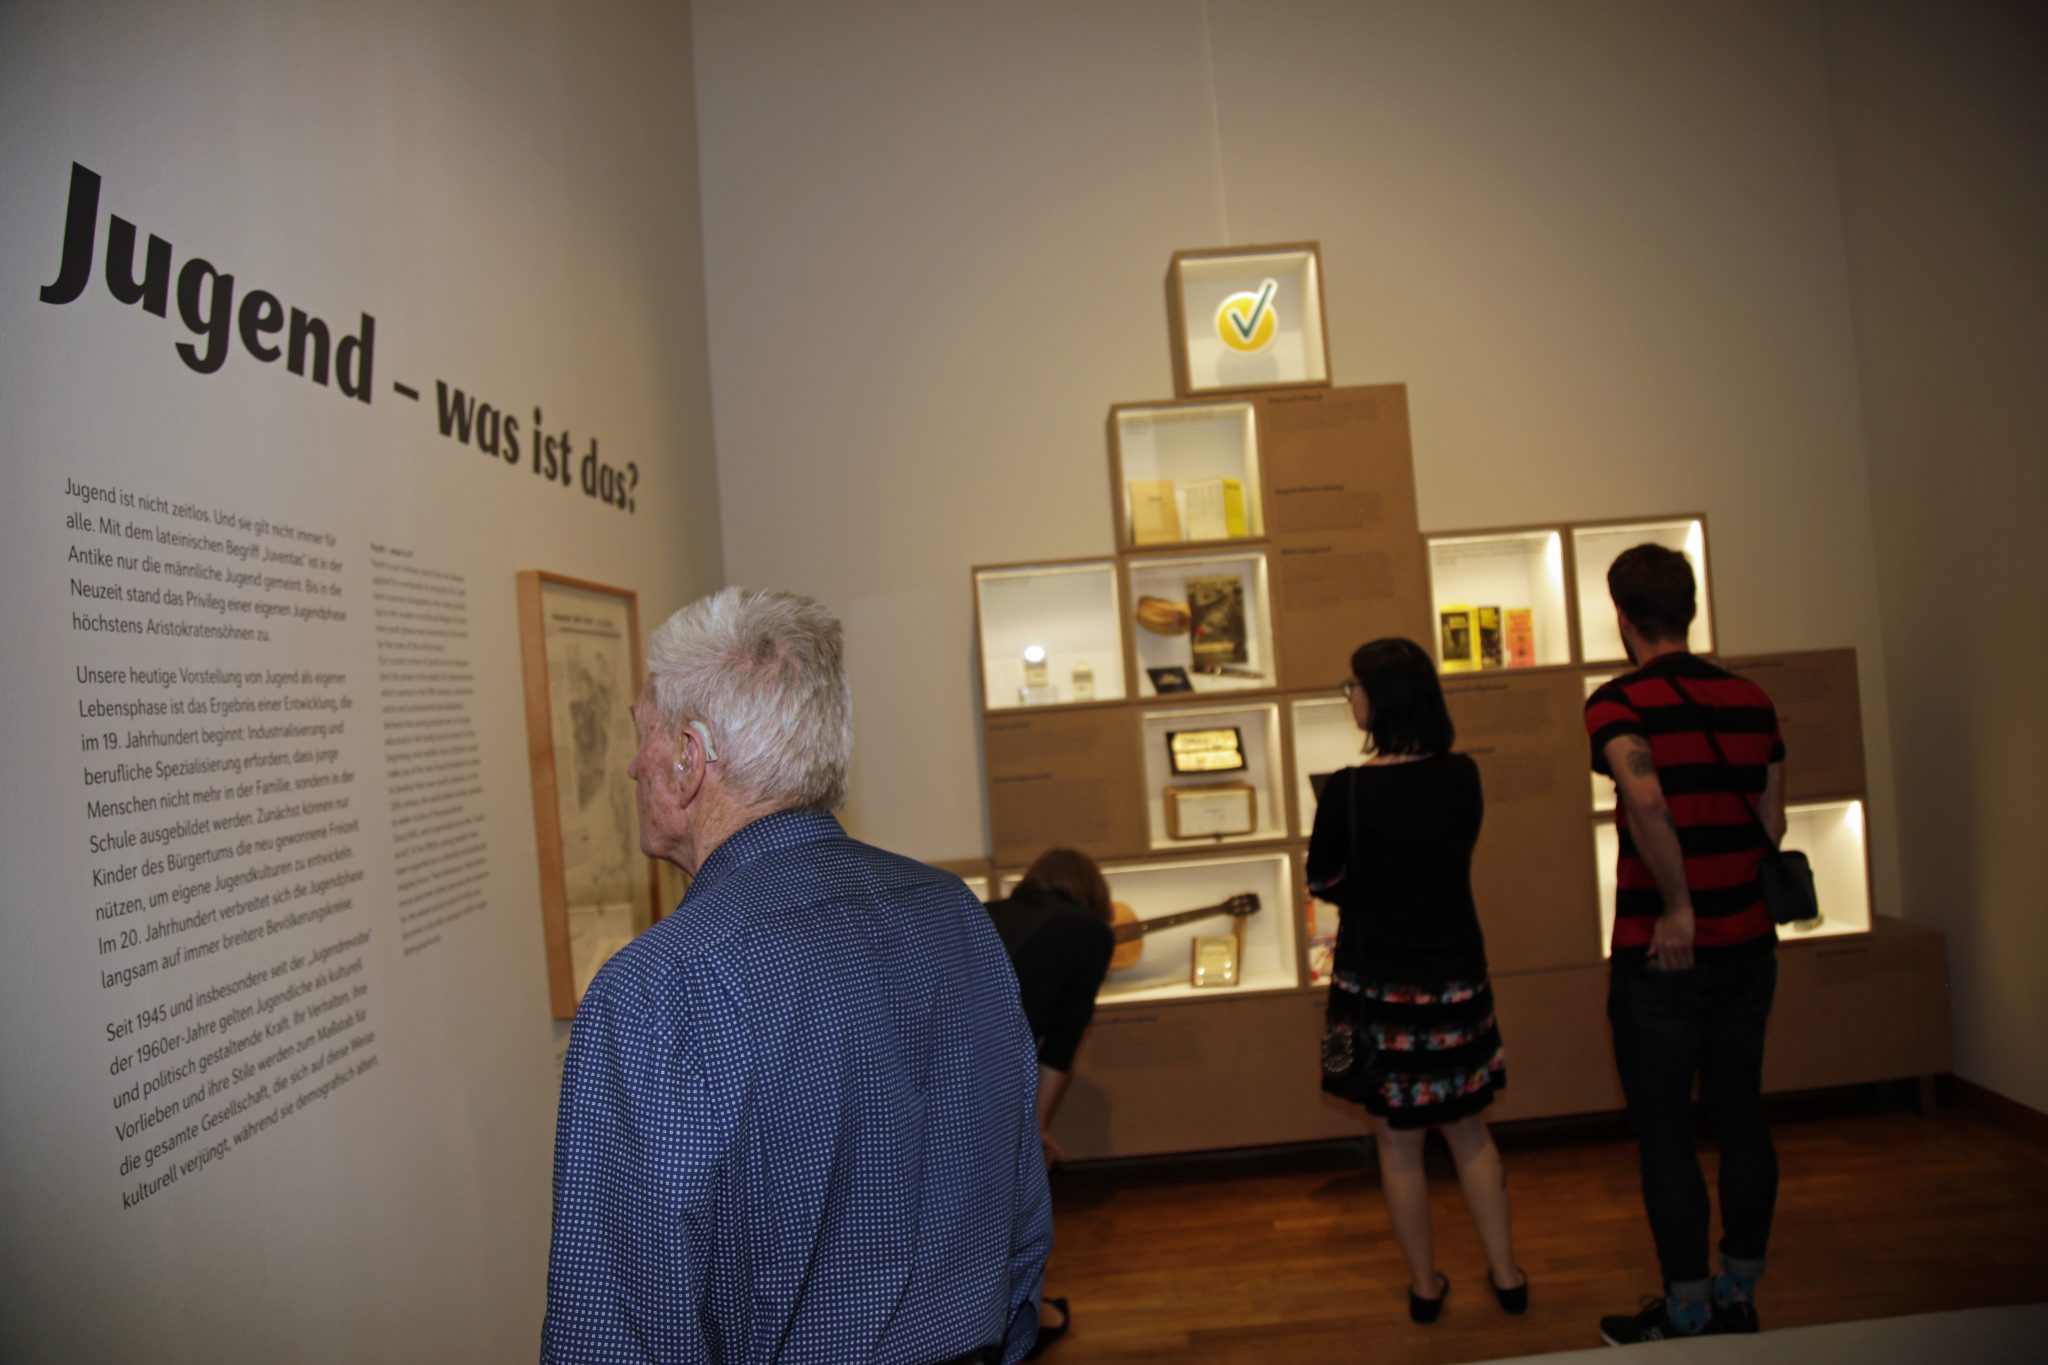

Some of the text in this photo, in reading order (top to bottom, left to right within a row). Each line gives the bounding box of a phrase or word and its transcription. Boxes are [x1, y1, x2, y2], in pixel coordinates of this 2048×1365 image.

[39, 161, 375, 404] Jugend
[435, 379, 520, 465] was
[532, 407, 572, 487] ist
[581, 437, 640, 514] das?
[64, 477, 116, 505] Jugend
[119, 489, 135, 508] ist
[139, 495, 169, 514] nicht
[172, 503, 211, 522] zeitlos.
[214, 509, 236, 527] Und
[238, 515, 252, 530] sie
[254, 519, 270, 536] gilt
[66, 512, 96, 532] alle.
[99, 517, 121, 536] Mit
[124, 521, 153, 542] dem
[156, 527, 224, 553] lateinischen
[226, 539, 260, 561] Begriff
[67, 545, 113, 567] Antike
[117, 556, 139, 570] nur
[142, 556, 161, 573] die
[164, 560, 223, 581] männliche
[225, 567, 262, 588] Jugend
[70, 579, 123, 600] Neuzeit
[126, 586, 161, 604] stand
[163, 589, 184, 606] das
[186, 592, 226, 614] Privileg
[228, 597, 253, 612] einer
[254, 599, 291, 618] eigenen
[73, 613, 143, 633] höchstens
[146, 618, 255, 640] Aristokratensöhnen
[77, 666, 126, 683] Unsere
[130, 667, 177, 688] heutige
[180, 668, 242, 687] Vorstellung
[244, 673, 263, 683] von
[264, 670, 299, 687] Jugend
[79, 699, 167, 720] Lebensphase
[170, 699, 185, 714] ist
[187, 698, 207, 713] das
[210, 697, 256, 717] Ergebnis
[258, 697, 283, 711] einer
[81, 734, 99, 751] im
[103, 733, 121, 750] 19.
[125, 728, 199, 748] Jahrhundert
[247, 723, 327, 740] Industrialisierung
[84, 763, 153, 785] berufliche
[156, 757, 242, 781] Spezialisierung
[87, 796, 157, 819] Menschen
[160, 790, 190, 809] nicht
[193, 786, 221, 804] mehr
[224, 785, 235, 800] in
[236, 783, 254, 798] der
[90, 830, 137, 853] Schule
[140, 817, 210, 845] ausgebildet
[256, 803, 301, 823] Zunächst
[93, 864, 138, 887] Kinder
[141, 859, 164, 877] des
[167, 847, 234, 871] Bürgertums
[236, 840, 253, 856] die
[255, 839, 273, 853] neu
[96, 898, 146, 921] nützen,
[149, 892, 169, 908] um
[172, 882, 212, 904] eigene
[214, 862, 293, 892] Jugendkulturen
[294, 859, 305, 871] zu
[99, 937, 117, 955] Im
[120, 928, 141, 949] 20.
[145, 907, 217, 942] Jahrhundert
[220, 892, 270, 920] verbreitet
[272, 887, 292, 905] sich
[293, 884, 308, 899] die
[101, 959, 159, 989] langsam
[162, 948, 181, 969] auf
[184, 940, 220, 962] immer
[223, 926, 264, 950] breitere
[107, 1016, 133, 1042] Seit
[137, 1004, 167, 1031] 1945
[170, 994, 193, 1018] und
[196, 971, 269, 1008] insbesondere
[270, 960, 288, 980] seit
[289, 957, 306, 972] der
[110, 1055, 133, 1076] der
[137, 1021, 217, 1065] 1960er-Jahre
[219, 1006, 254, 1035] gelten
[255, 980, 313, 1015] Jugendliche
[113, 1082, 140, 1110] und
[144, 1057, 196, 1101] politisch
[199, 1030, 263, 1076] gestaltende
[293, 1010, 306, 1028] Ihr
[116, 1101, 180, 1143] Vorlieben
[183, 1085, 205, 1110] und
[208, 1077, 230, 1098] ihre
[232, 1063, 256, 1086] Stile
[258, 1045, 295, 1073] werden
[296, 1035, 316, 1054] zum
[120, 1154, 141, 1177] die
[145, 1123, 199, 1168] gesamte
[202, 1084, 272, 1133] Gesellschaft,
[273, 1077, 289, 1095] die
[291, 1063, 310, 1086] sich
[123, 1164, 178, 1210] kulturell
[181, 1136, 232, 1178] verjüngt,
[234, 1108, 279, 1147] während
[281, 1103, 294, 1121] sie
